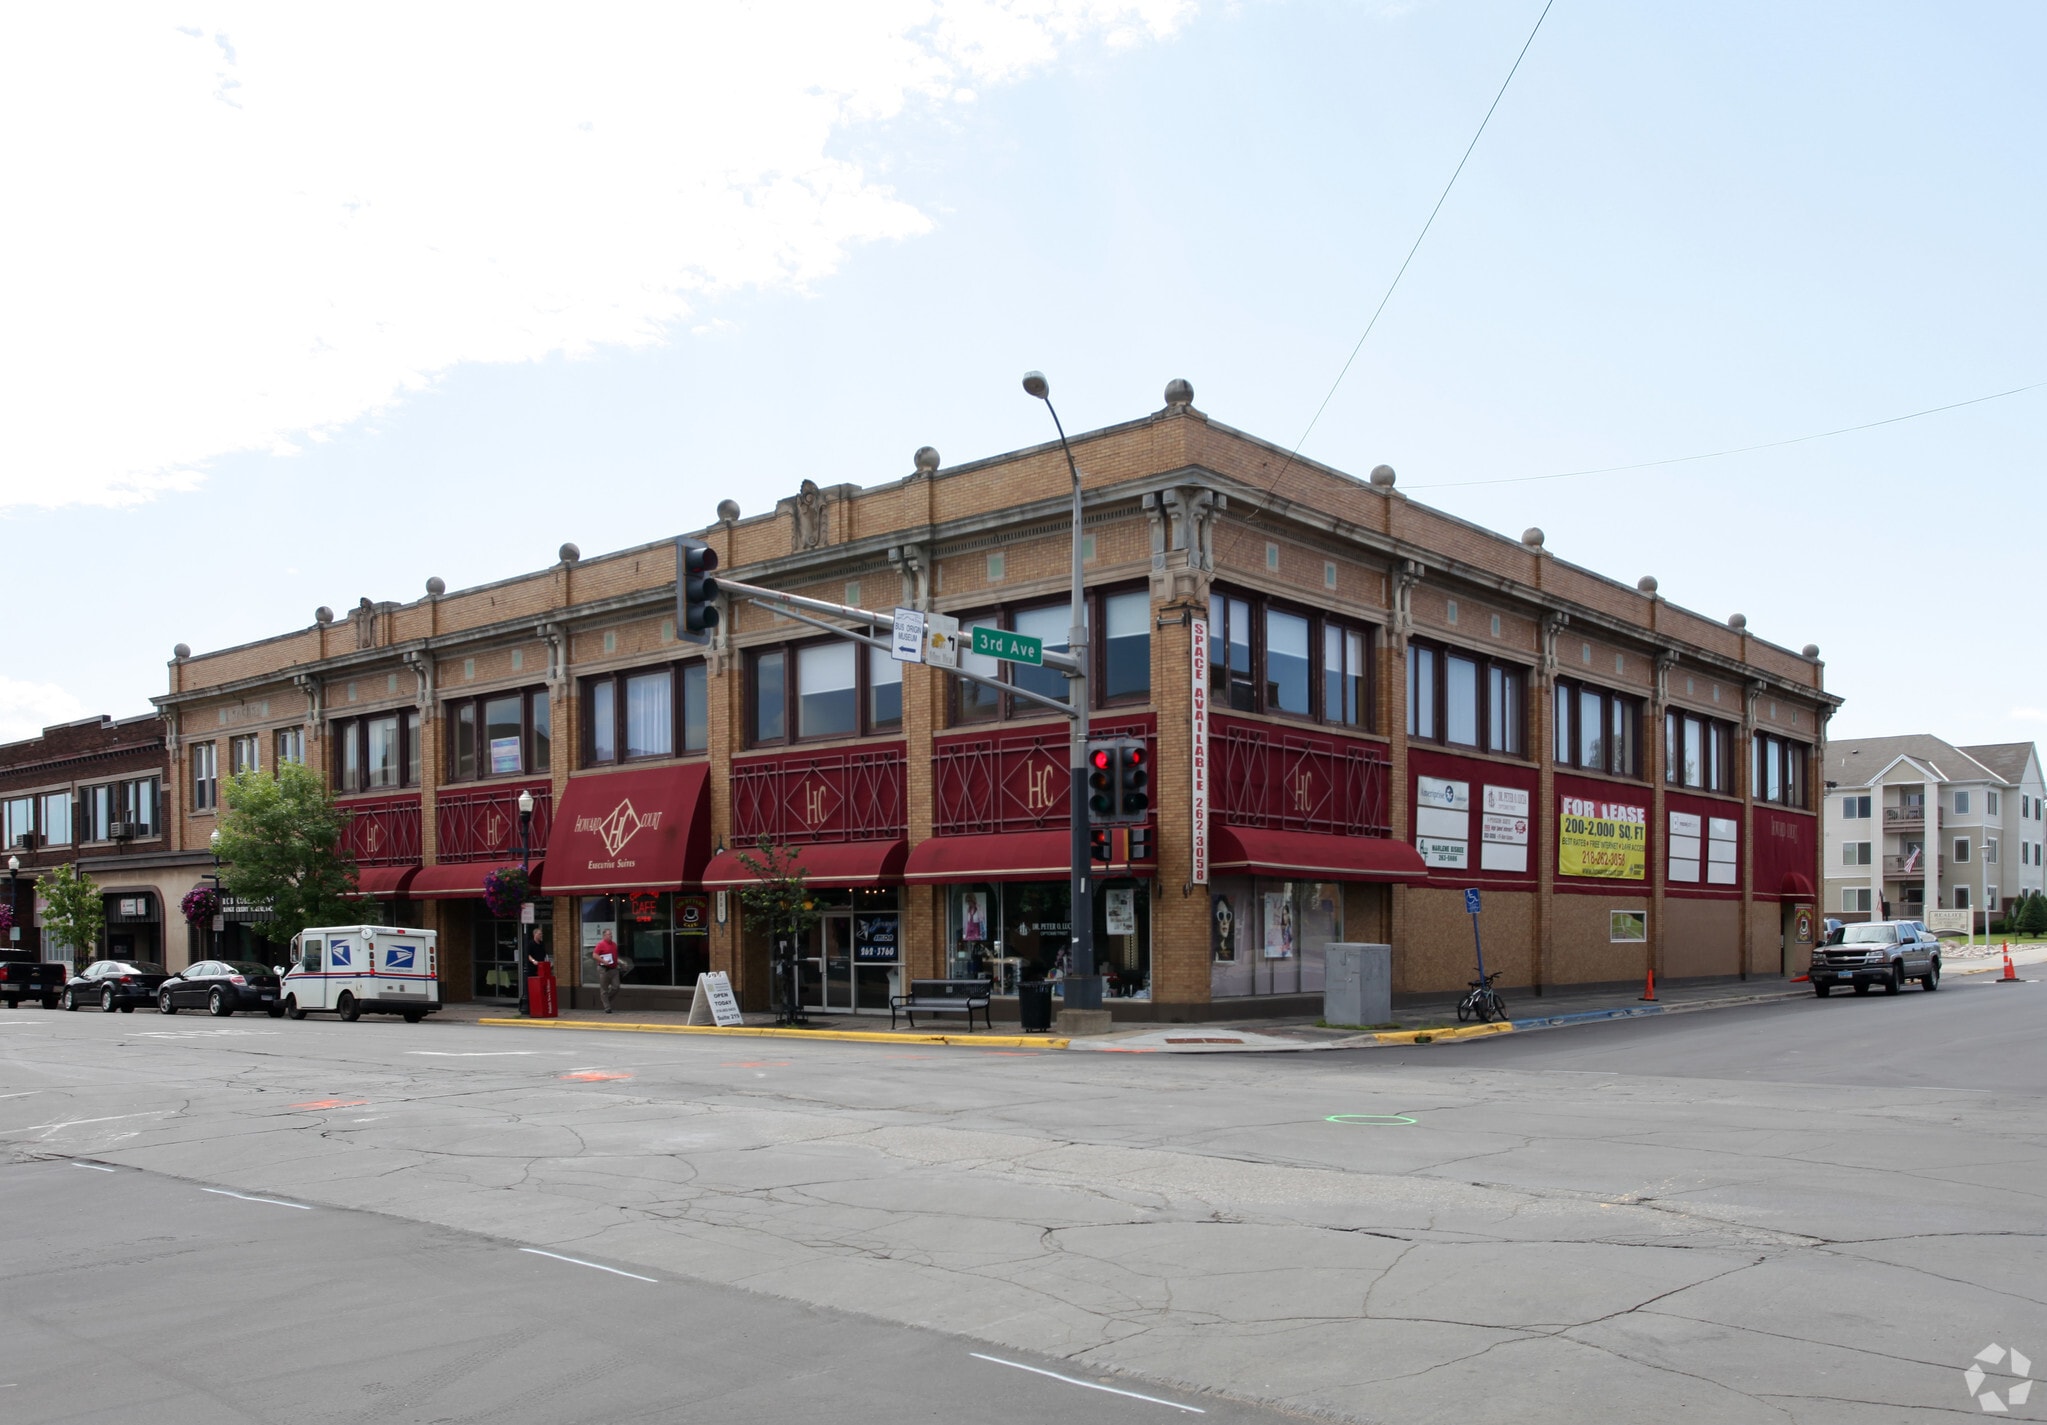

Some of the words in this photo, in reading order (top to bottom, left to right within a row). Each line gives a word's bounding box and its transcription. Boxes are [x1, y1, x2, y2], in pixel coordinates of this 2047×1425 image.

[895, 622, 905, 631] BUS
[906, 624, 921, 634] ORIGIN
[898, 632, 918, 642] MUSEUM
[980, 634, 1003, 652] 3rd
[1010, 641, 1035, 658] Ave
[1194, 624, 1204, 680] SPACE
[1194, 688, 1204, 790] AVAILABLE
[1027, 760, 1054, 808] HC
[1294, 762, 1312, 812] HC
[806, 780, 827, 824] HC
[1564, 798, 1594, 818] FOR
[1602, 804, 1645, 824] LEASE
[366, 820, 378, 852] HC
[486, 810, 500, 846] HC
[1565, 818, 1614, 838] 200-2,000
[1619, 824, 1632, 840] SQ.
[1634, 826, 1644, 840] FT
[1562, 837, 1573, 846] BEST
[632, 900, 657, 915] CAFE
[1041, 922, 1056, 930] PETER
